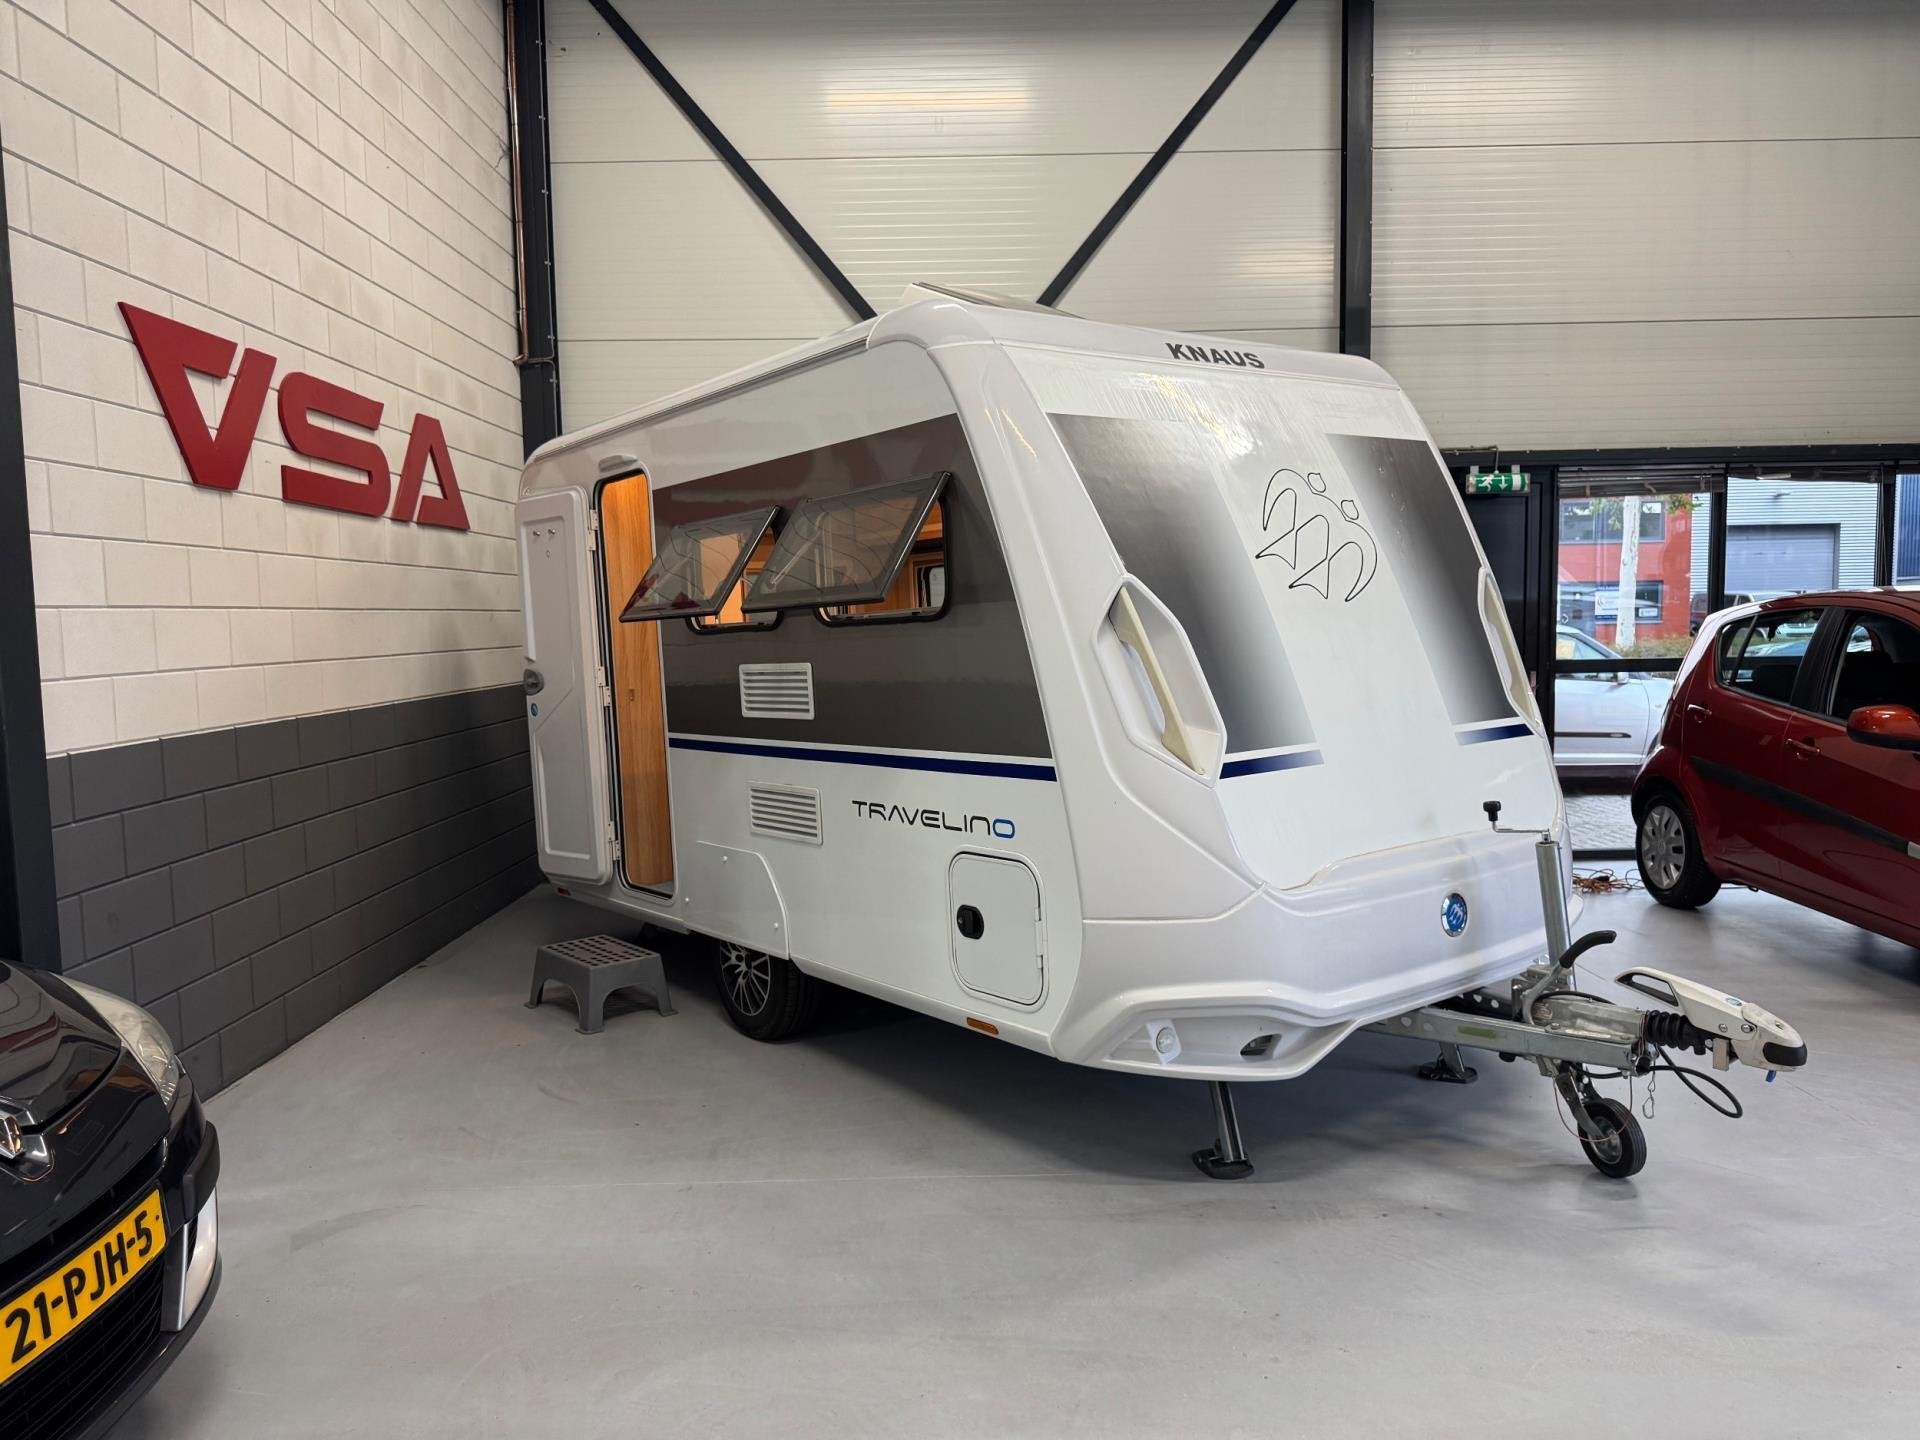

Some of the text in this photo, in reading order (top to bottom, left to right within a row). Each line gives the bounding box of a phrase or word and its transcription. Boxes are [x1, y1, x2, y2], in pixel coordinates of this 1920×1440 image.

[117, 301, 470, 530] VSA
[1165, 342, 1265, 369] KNAUS
[5, 1210, 153, 1364] 21-PJH-5
